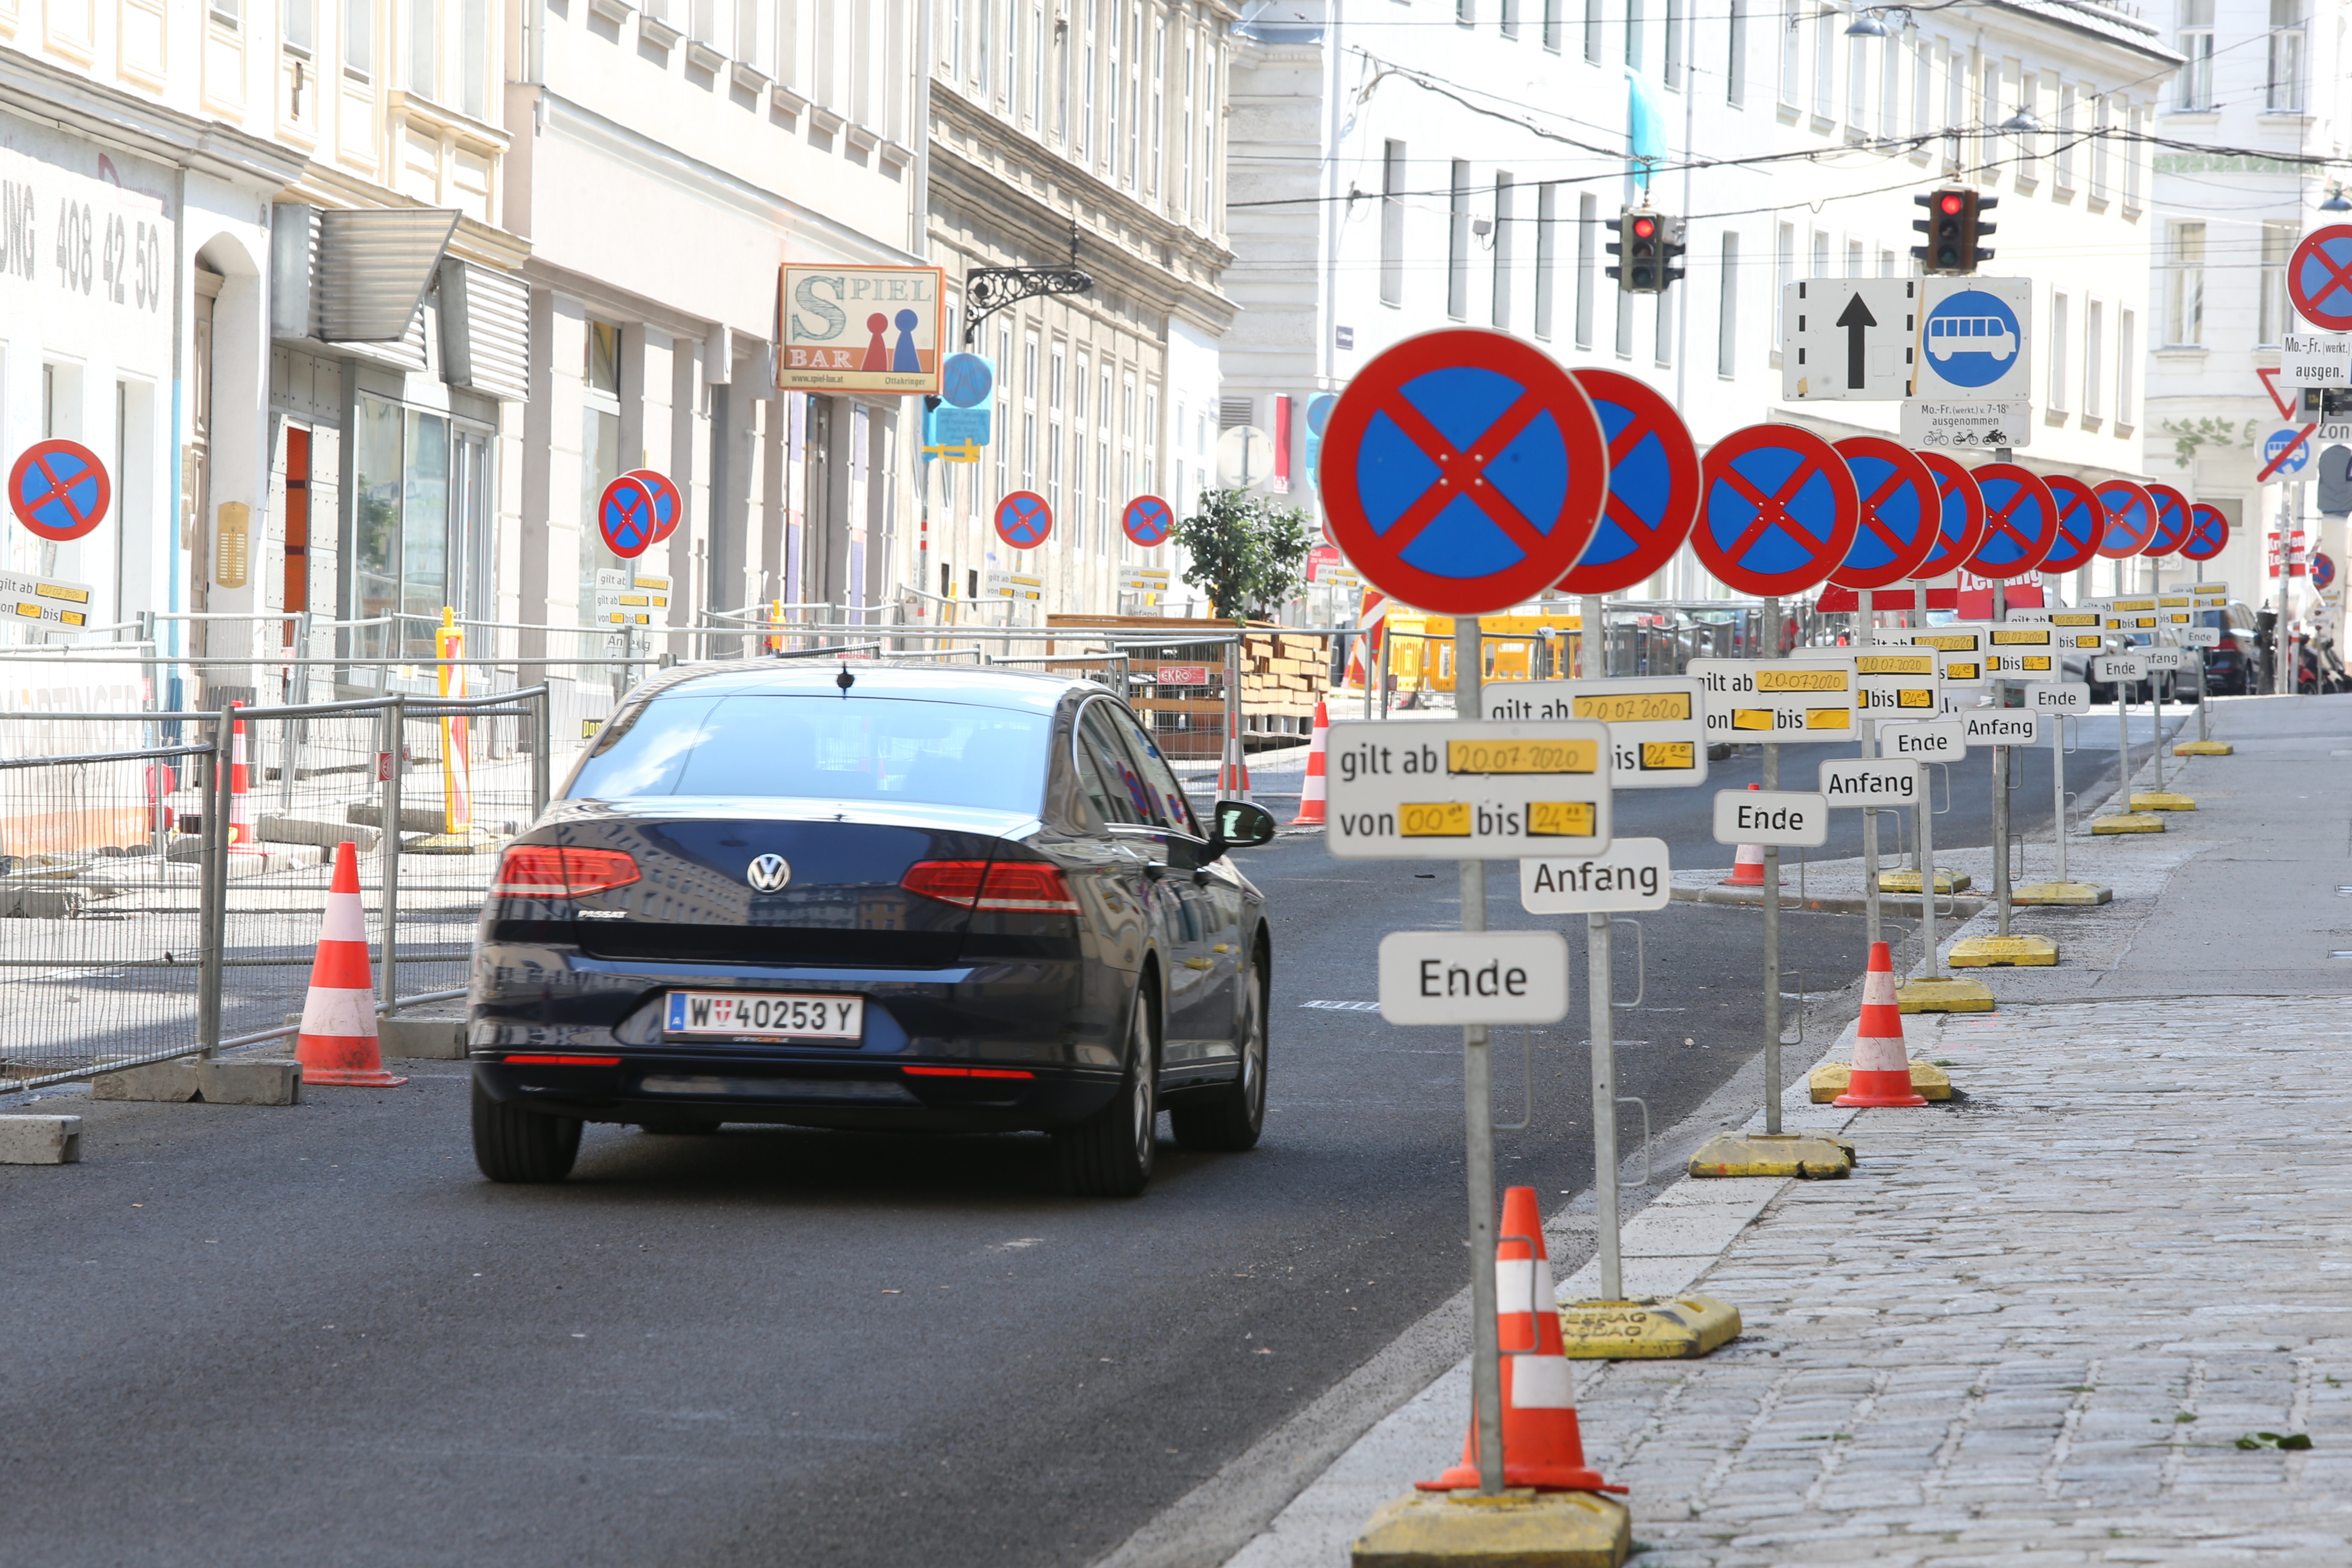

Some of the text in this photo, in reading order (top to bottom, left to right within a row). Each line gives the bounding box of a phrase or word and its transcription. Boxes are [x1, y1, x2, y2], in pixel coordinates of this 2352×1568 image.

[56, 197, 92, 296] 408
[103, 212, 125, 305] 42
[135, 220, 159, 314] 50
[791, 275, 932, 343] SPIEL
[2285, 337, 2350, 356] Mo.-Fr. (werkt.)
[790, 349, 853, 368] BAR
[791, 373, 844, 385] www.spiel-bar.at
[885, 376, 926, 387] Ottakringer
[2296, 365, 2344, 382] ausgen.
[1922, 404, 1952, 414] Mo.-Fr.
[1952, 406, 1978, 415] (werkt.)
[1932, 417, 1999, 428] ausgenommen
[2318, 423, 2352, 439] Zon
[2269, 536, 2304, 551] Kren
[600, 574, 614, 584] gilt
[988, 574, 1000, 582] gilt
[19, 582, 33, 594] ab
[597, 595, 608, 606] gilt
[610, 596, 618, 605] ab
[0, 603, 14, 613] on
[43, 608, 59, 621] bis
[597, 614, 609, 623] von
[625, 614, 634, 624] bis
[2122, 618, 2135, 629] bis
[2059, 637, 2074, 648] bis
[2189, 633, 2212, 641] Ende
[2002, 657, 2020, 670] bis
[2145, 653, 2177, 665] nfang
[1161, 670, 1190, 682] EKRO
[2106, 662, 2136, 676] Ende
[1732, 674, 1753, 692] ab
[1871, 691, 1895, 707] bis
[2038, 691, 2077, 706] Ende
[1541, 698, 1569, 720] ab
[1707, 710, 1803, 730] on bis
[1967, 720, 2033, 737] Anfang
[1898, 733, 1948, 752] Ende
[1340, 743, 1393, 781] gilt
[1402, 743, 1438, 774] ab
[1611, 744, 1635, 770] is
[1828, 772, 1913, 797] Anfang
[1340, 813, 1394, 837] von
[1477, 803, 1520, 837] bis
[1738, 805, 1803, 831] Ende
[746, 853, 791, 895] VW
[1534, 861, 1658, 897] Anfang
[577, 910, 628, 919] PASSAT
[1420, 958, 1528, 998] Ende
[691, 998, 851, 1030] W 40253 Y
